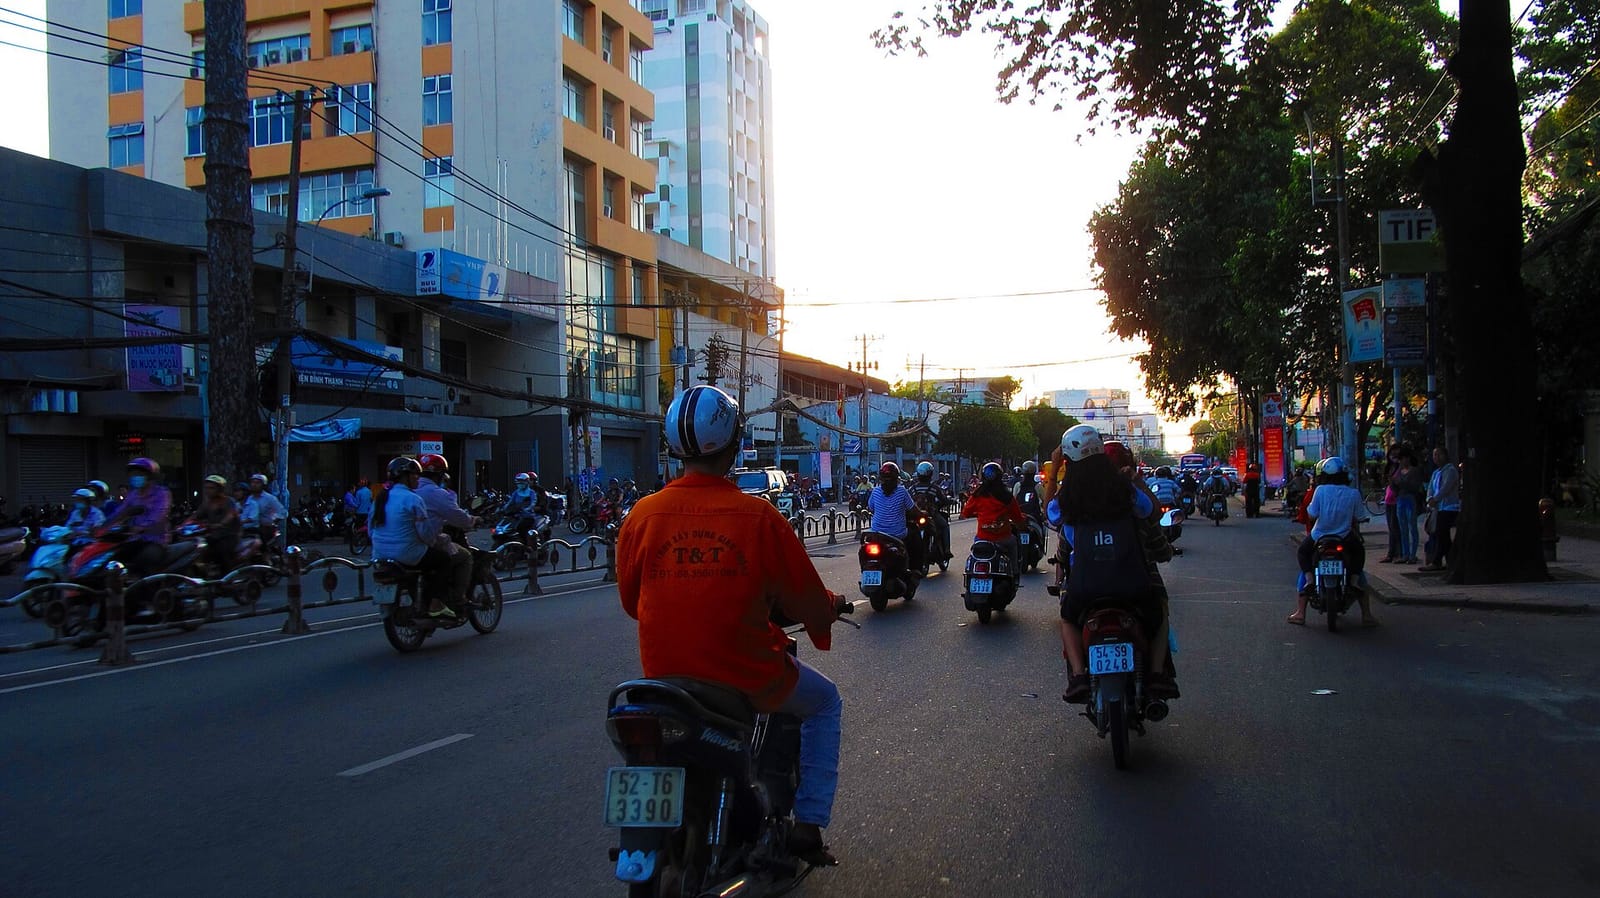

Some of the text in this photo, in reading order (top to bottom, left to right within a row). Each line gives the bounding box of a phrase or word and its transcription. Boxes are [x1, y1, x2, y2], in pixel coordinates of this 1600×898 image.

[673, 547, 724, 564] T&T
[1095, 645, 1127, 659] 54-S9
[1096, 658, 1128, 672] 0248
[618, 772, 673, 796] 52-T6
[616, 799, 672, 822] 3390
